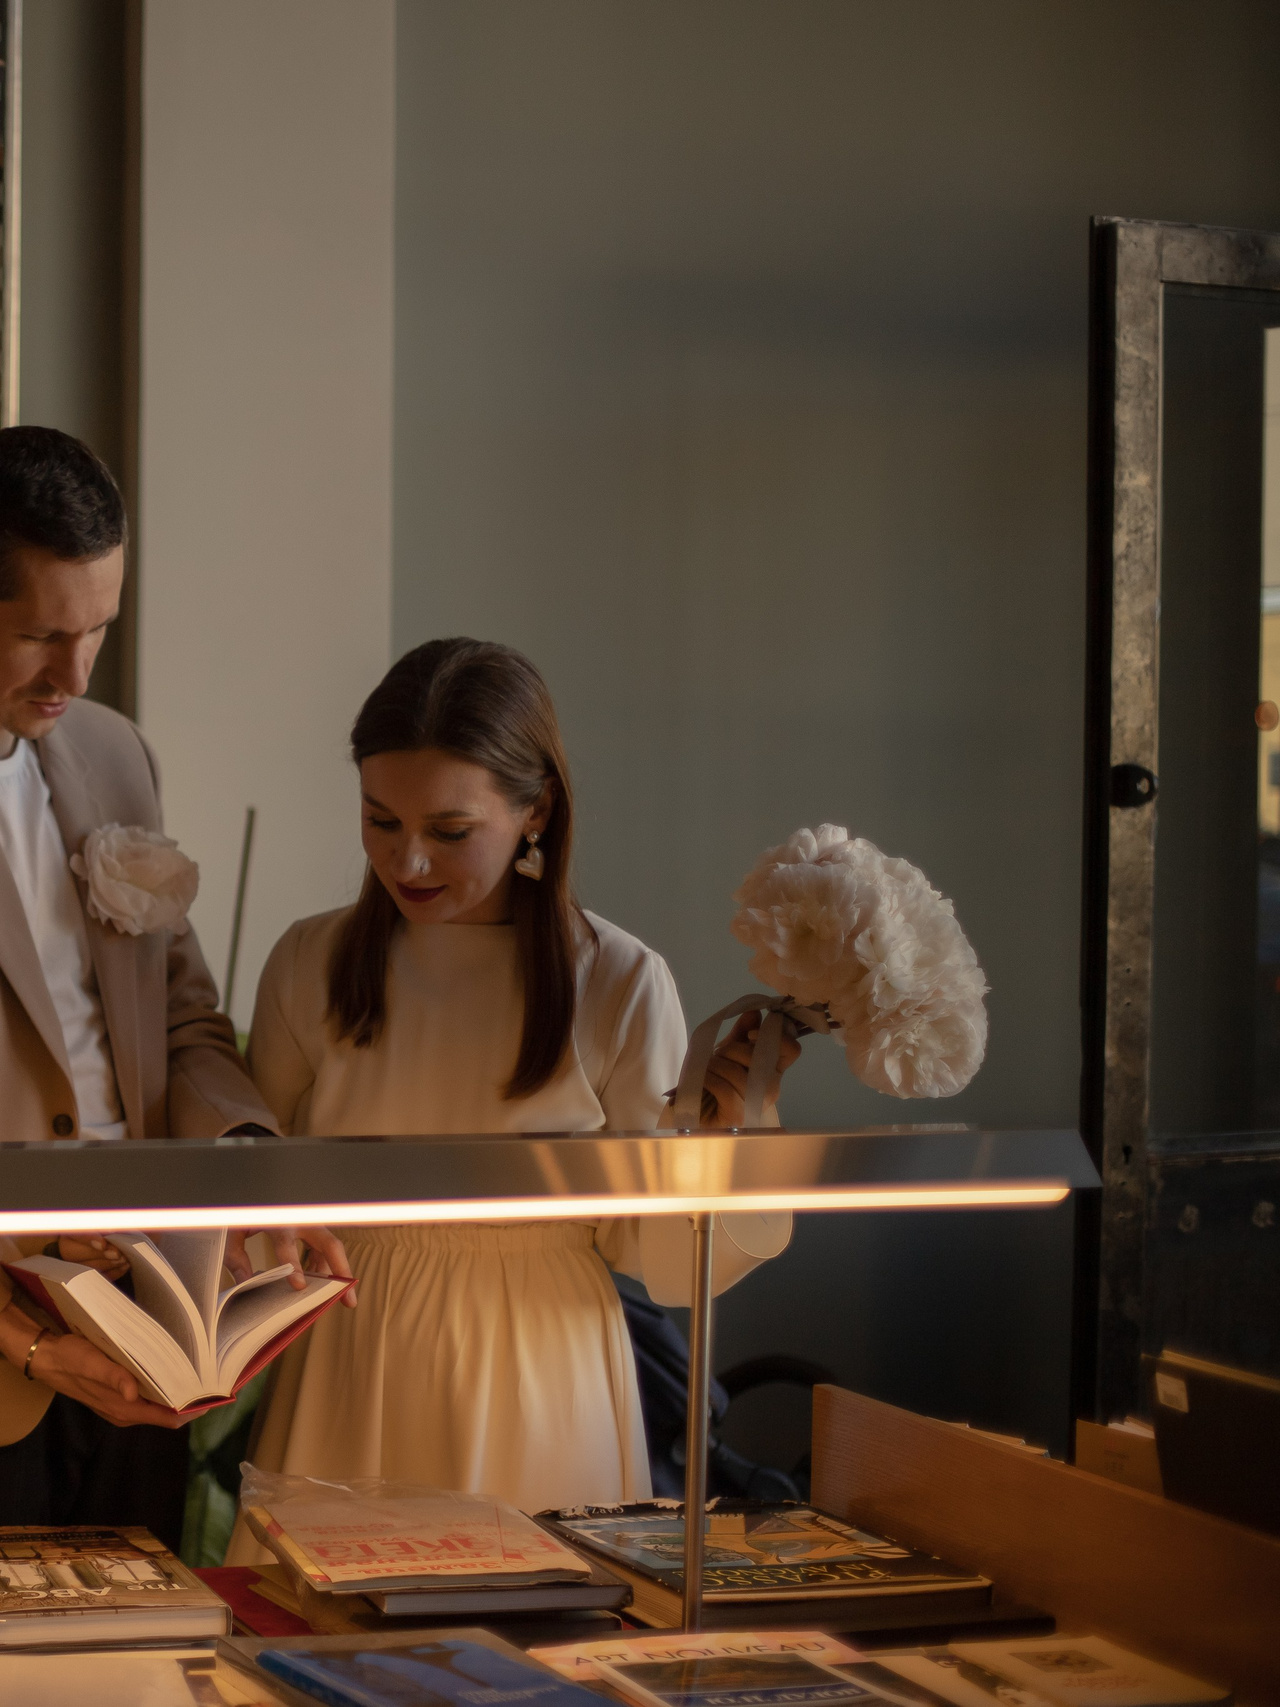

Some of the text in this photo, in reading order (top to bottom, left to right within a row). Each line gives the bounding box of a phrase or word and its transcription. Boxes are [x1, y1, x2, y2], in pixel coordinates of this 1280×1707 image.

[835, 1563, 874, 1571] IN
[126, 1583, 188, 1591] The
[16, 1586, 112, 1600] ABC
